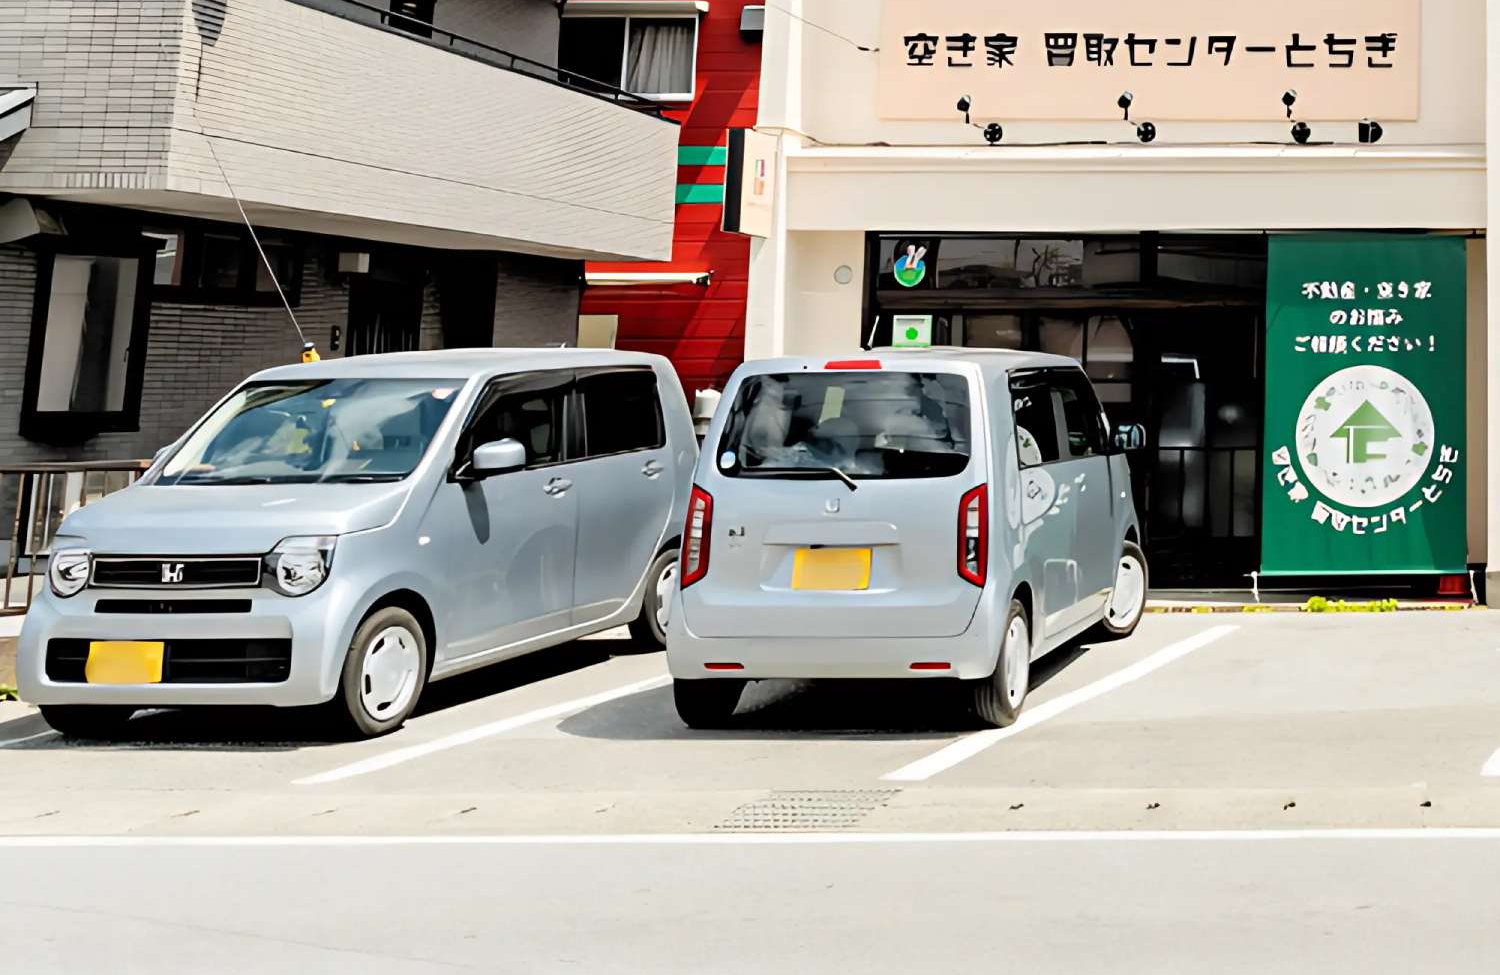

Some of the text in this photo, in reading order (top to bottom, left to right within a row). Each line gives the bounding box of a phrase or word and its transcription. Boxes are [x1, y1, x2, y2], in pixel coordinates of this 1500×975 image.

[903, 32, 1398, 69] 空き家 買取センターとちぎ
